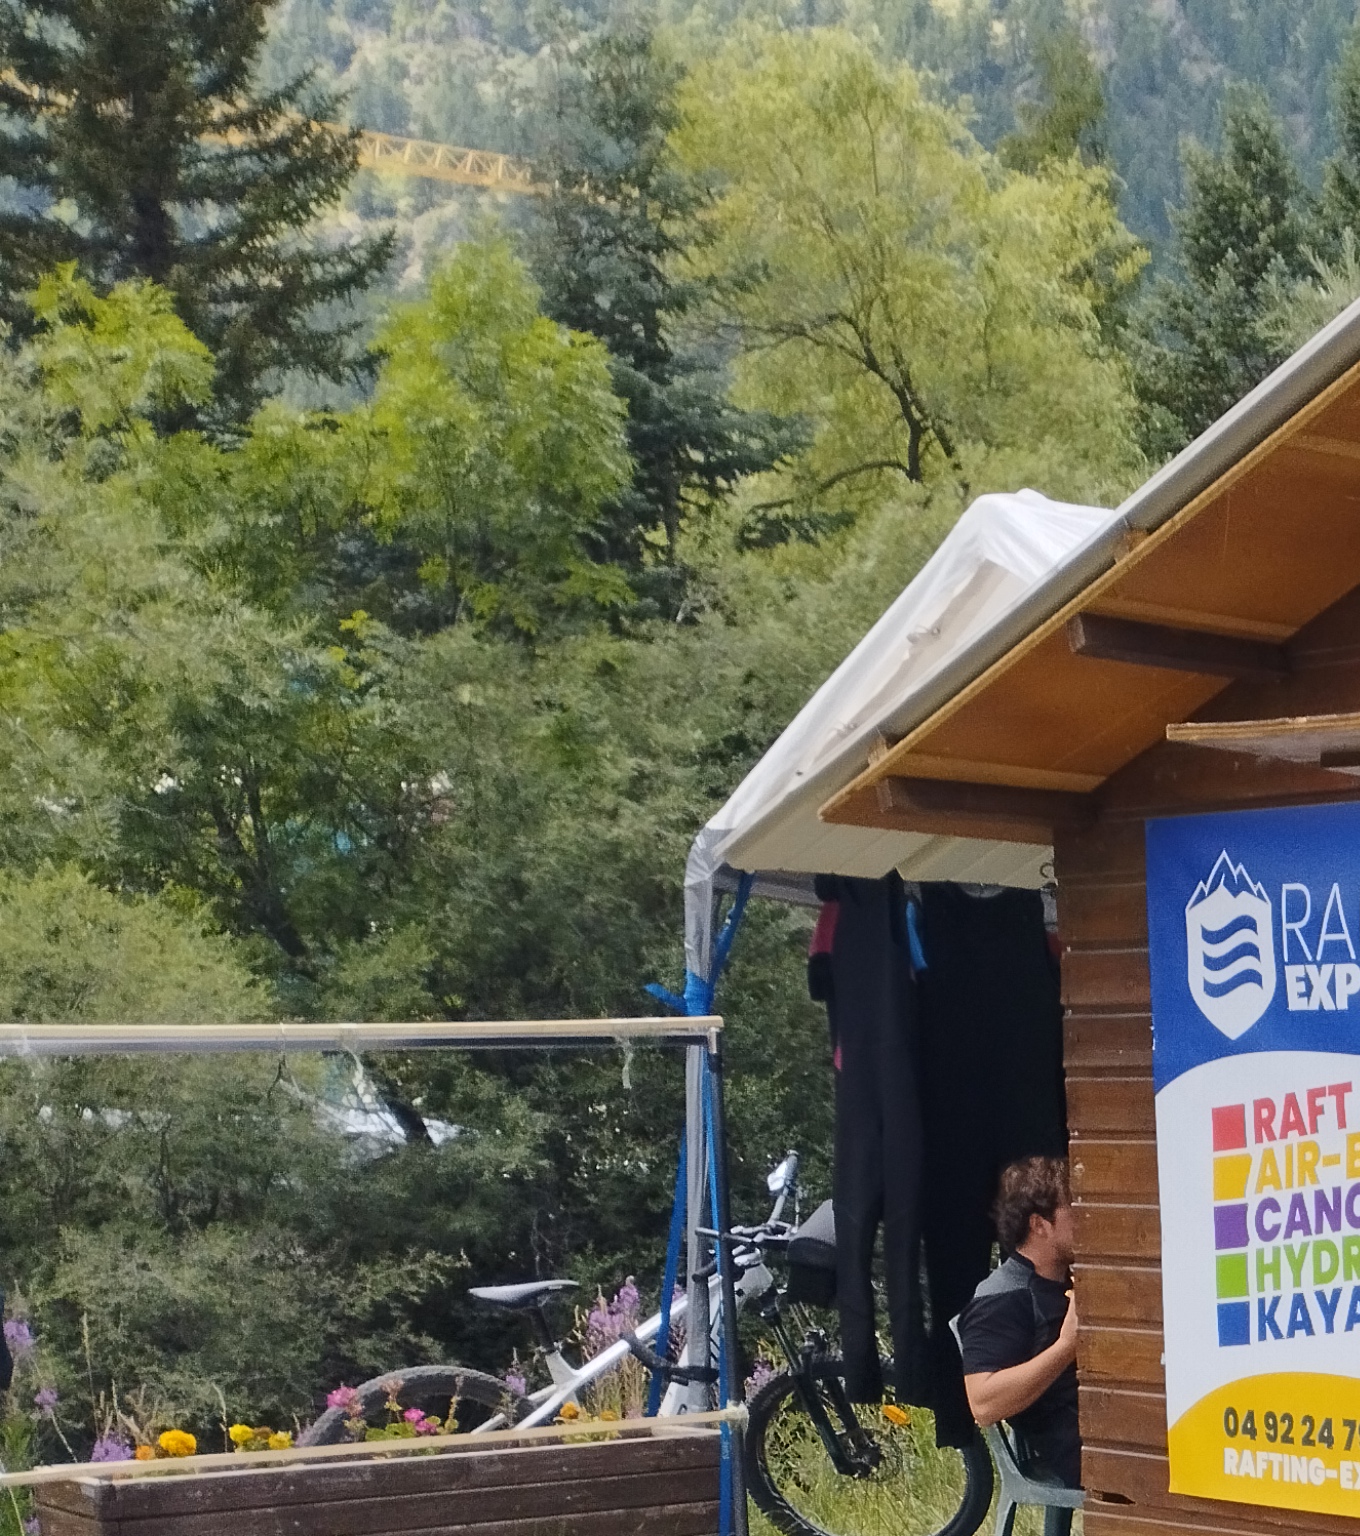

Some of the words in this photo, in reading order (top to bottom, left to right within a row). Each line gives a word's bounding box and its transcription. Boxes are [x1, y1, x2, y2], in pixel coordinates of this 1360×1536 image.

[1253, 1082, 1353, 1145] RAFT
[1223, 1407, 1258, 1440] 04
[1264, 1411, 1295, 1444] 92
[1300, 1415, 1336, 1448] 24
